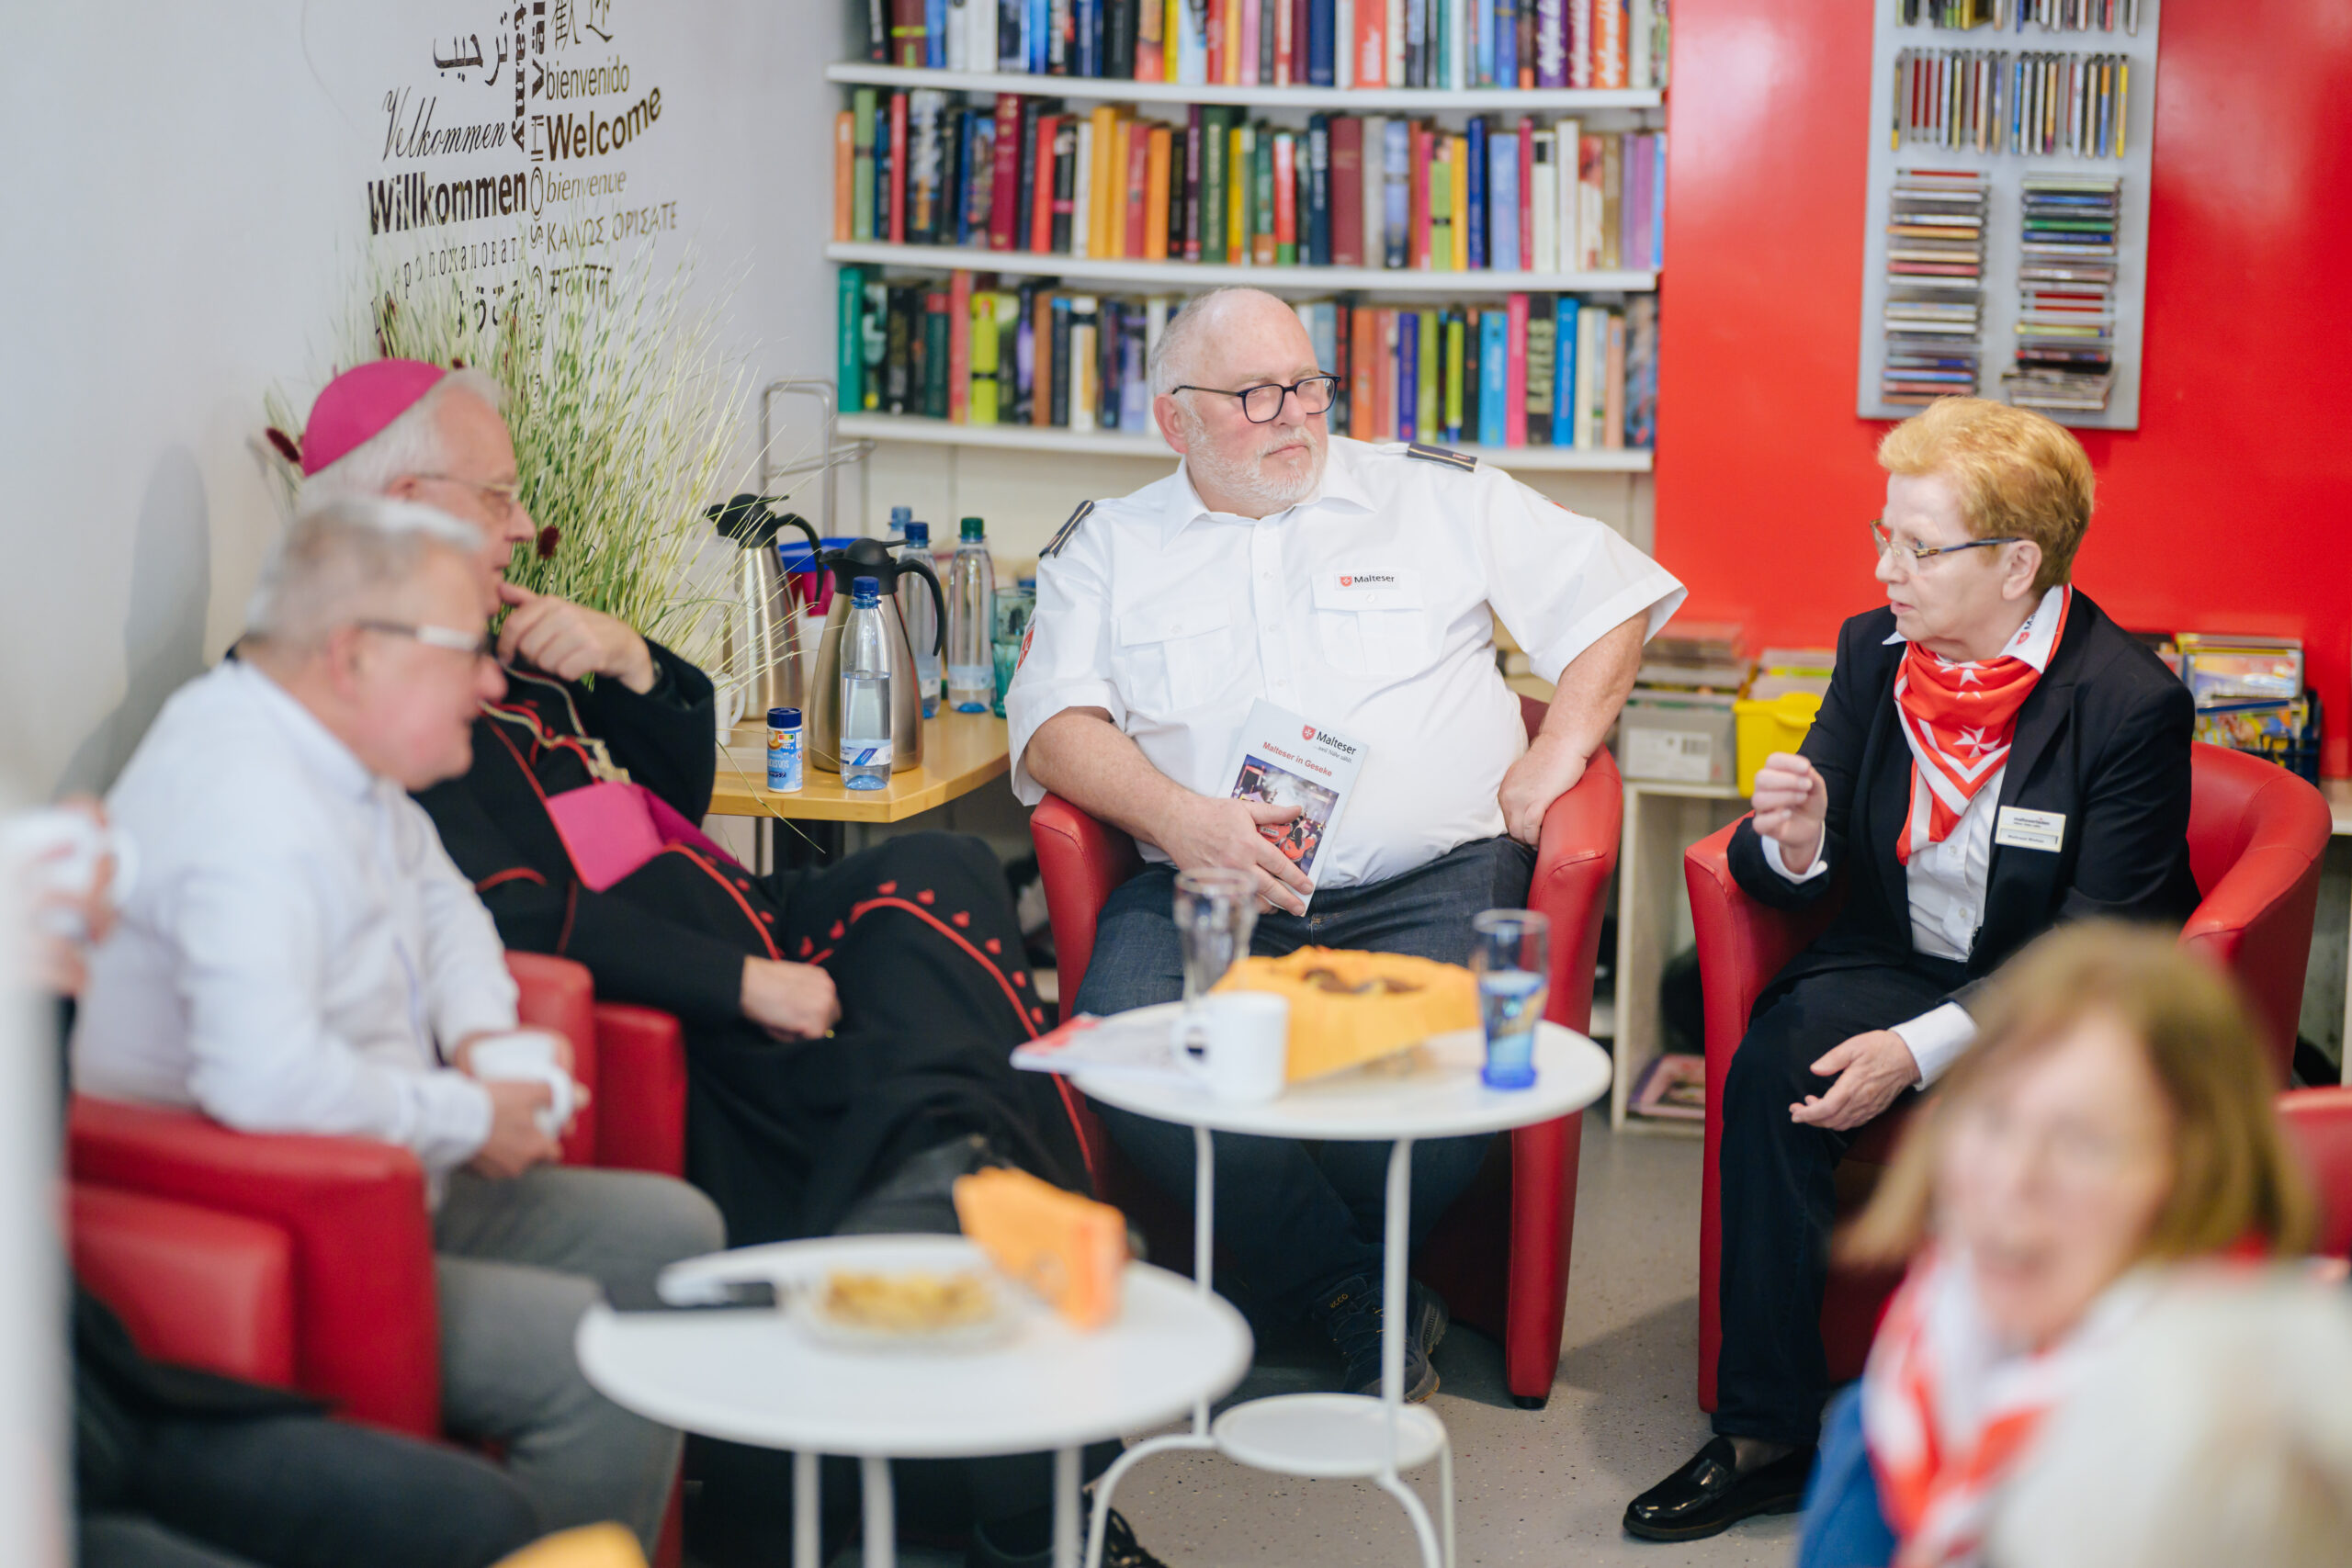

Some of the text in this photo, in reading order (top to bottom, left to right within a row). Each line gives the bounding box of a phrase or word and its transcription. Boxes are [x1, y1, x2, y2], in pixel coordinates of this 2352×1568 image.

[511, 0, 527, 152] tamy
[546, 54, 630, 101] bienvenido
[382, 86, 508, 163] Velkommen
[546, 86, 662, 163] Welcome
[368, 171, 527, 236] Willkommen
[546, 170, 628, 204] bienvenue
[1354, 575, 1395, 583] Malteser
[1262, 741, 1332, 777] Malteser in Geseke
[1317, 731, 1356, 755] Malteser
